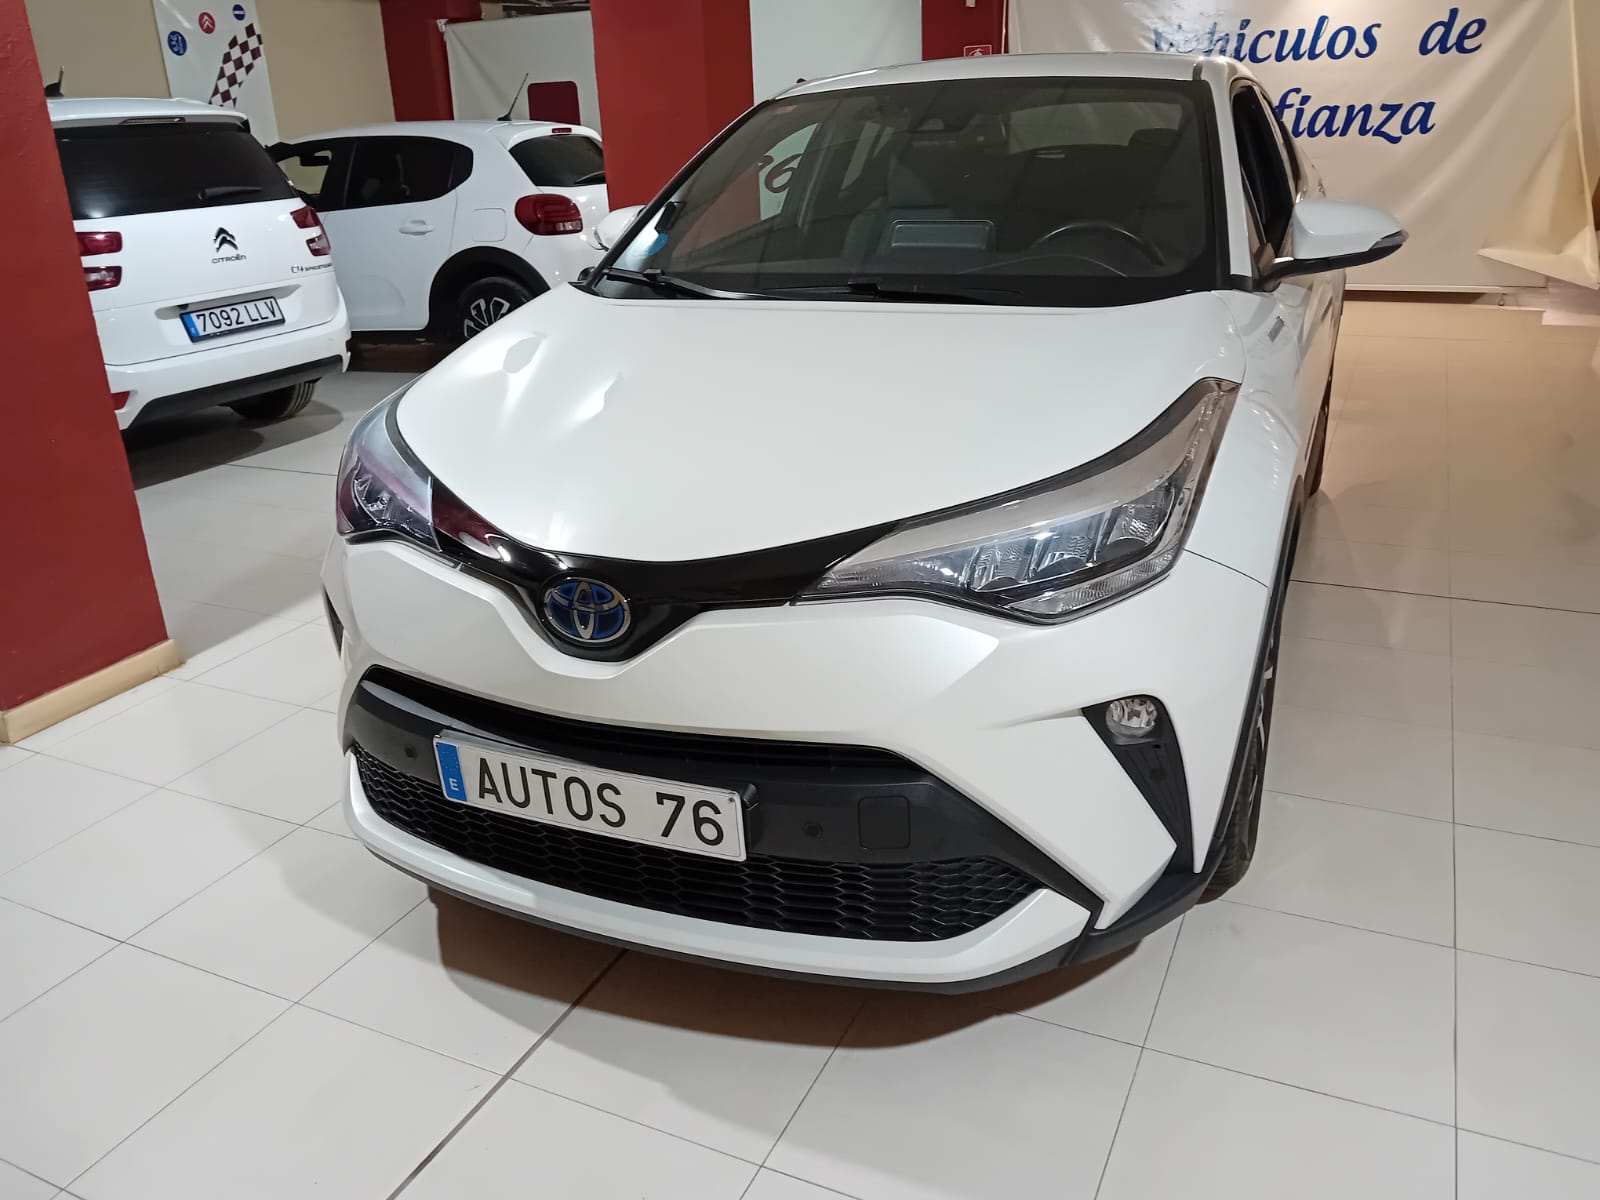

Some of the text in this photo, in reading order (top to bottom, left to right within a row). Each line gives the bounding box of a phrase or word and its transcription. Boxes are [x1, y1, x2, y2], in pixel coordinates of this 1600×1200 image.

[1418, 7, 1487, 56] de
[196, 301, 276, 332] 7092 LLV
[448, 777, 459, 791] E
[478, 757, 724, 846] AUTOS 76
